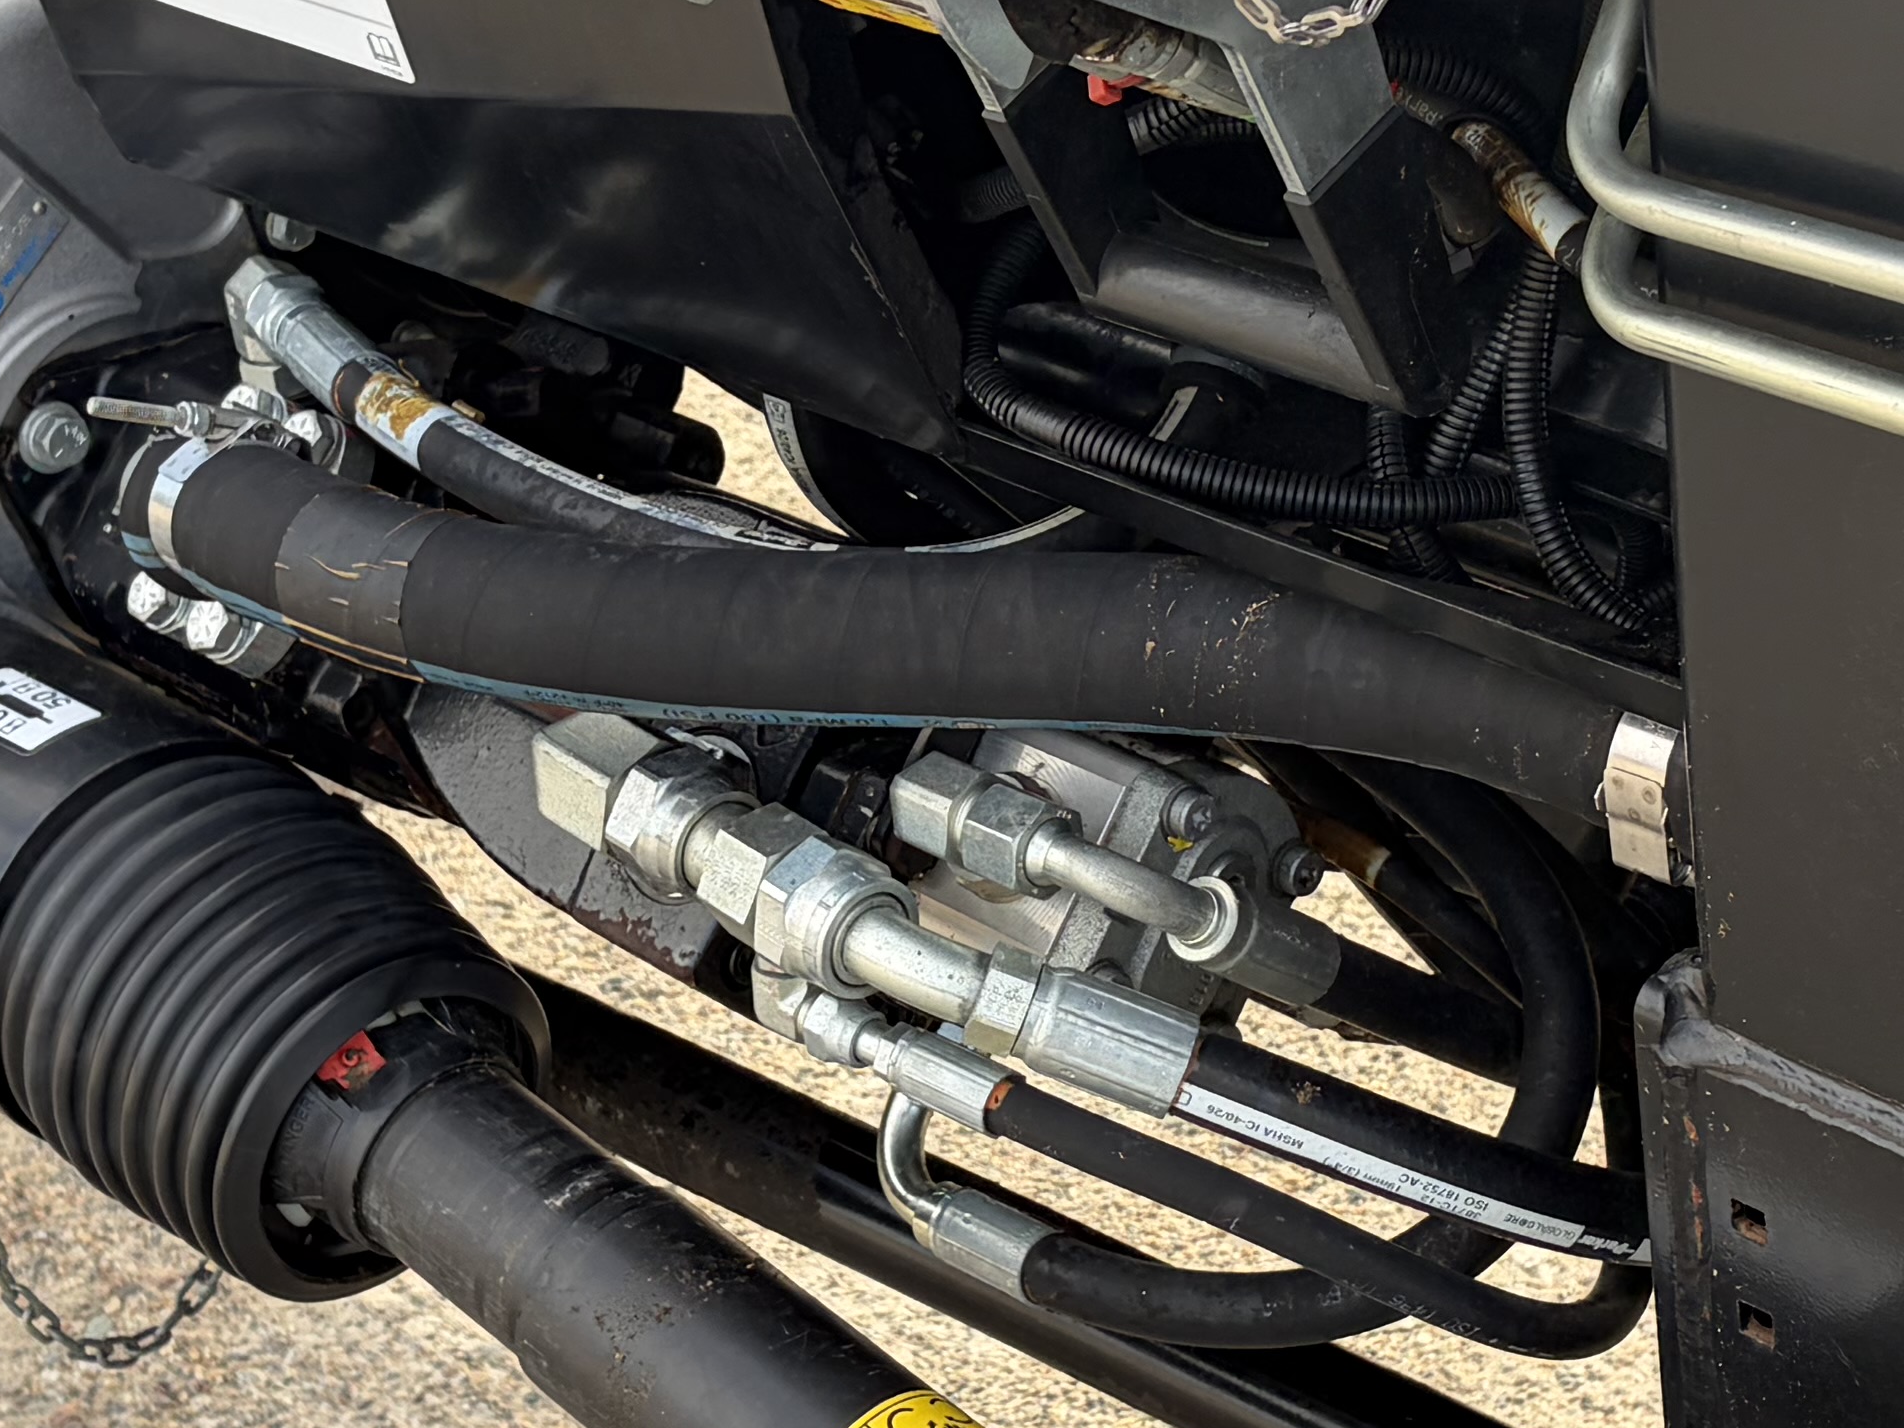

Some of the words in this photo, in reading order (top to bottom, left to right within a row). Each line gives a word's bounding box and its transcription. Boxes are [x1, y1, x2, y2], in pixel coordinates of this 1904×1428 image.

[1263, 1127, 1304, 1150] MSHA
[1398, 1172, 1460, 1202] 18752-AC
[1464, 1196, 1489, 1212] ISO
[1577, 1234, 1636, 1255] Parker
